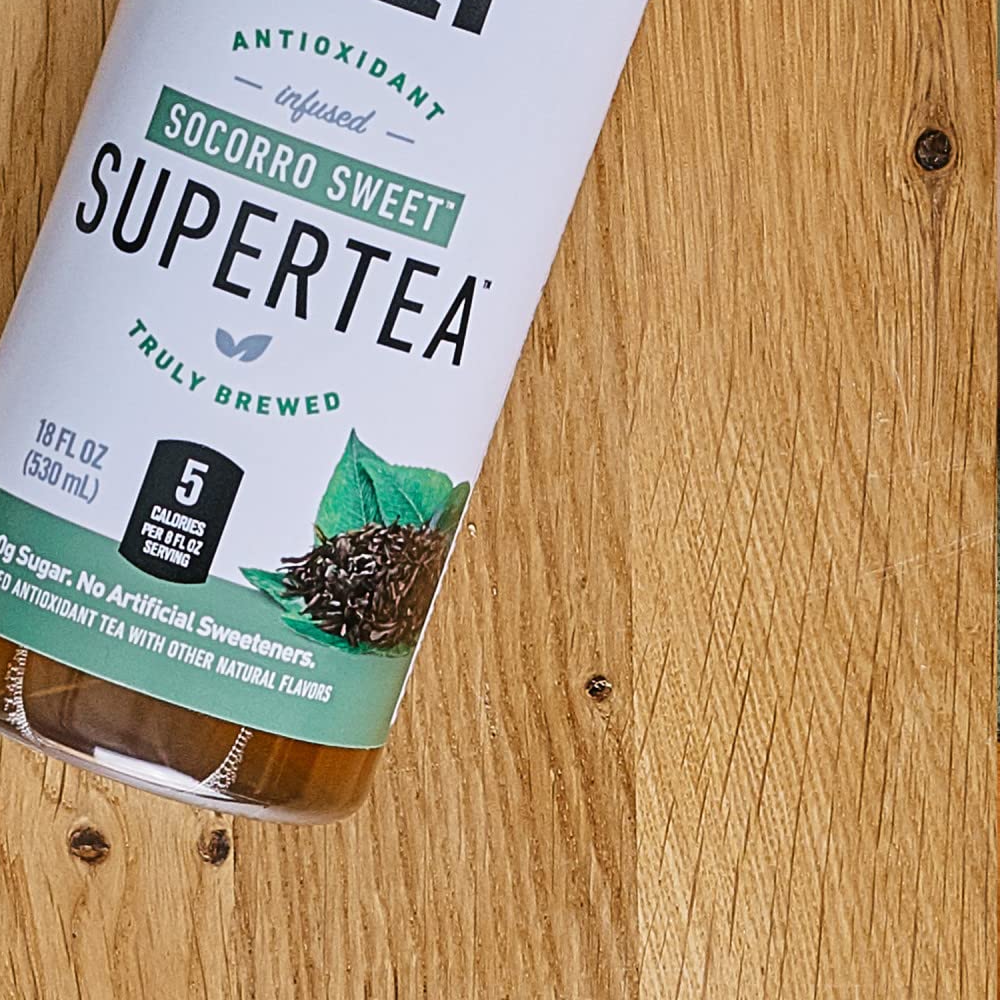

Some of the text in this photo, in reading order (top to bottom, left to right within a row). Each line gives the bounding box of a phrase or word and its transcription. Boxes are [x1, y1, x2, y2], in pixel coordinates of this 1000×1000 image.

[232, 29, 445, 121] ANTIOXIDANT
[274, 85, 377, 135] infused
[164, 102, 318, 189] SOCORRO
[129, 318, 342, 417] TRULY BREWED
[35, 418, 110, 470] 18 FL OZ
[22, 449, 101, 505] (530 mL)
[175, 458, 210, 507] 5
[141, 522, 205, 556] PER 8 FL OZ
[150, 505, 208, 538] CALORIES
[142, 540, 192, 568] SERVING
[15, 545, 74, 588] Sugar.
[75, 571, 107, 598] No
[105, 584, 196, 633] Artificial
[196, 615, 317, 669] Sweeteners.
[11, 578, 99, 628] ANTIOXIDANT
[99, 613, 126, 640] TEA
[128, 625, 167, 654] WITH
[166, 639, 216, 671] OTHER
[215, 655, 277, 690] NATURAL
[278, 674, 334, 703] FLAVORS
